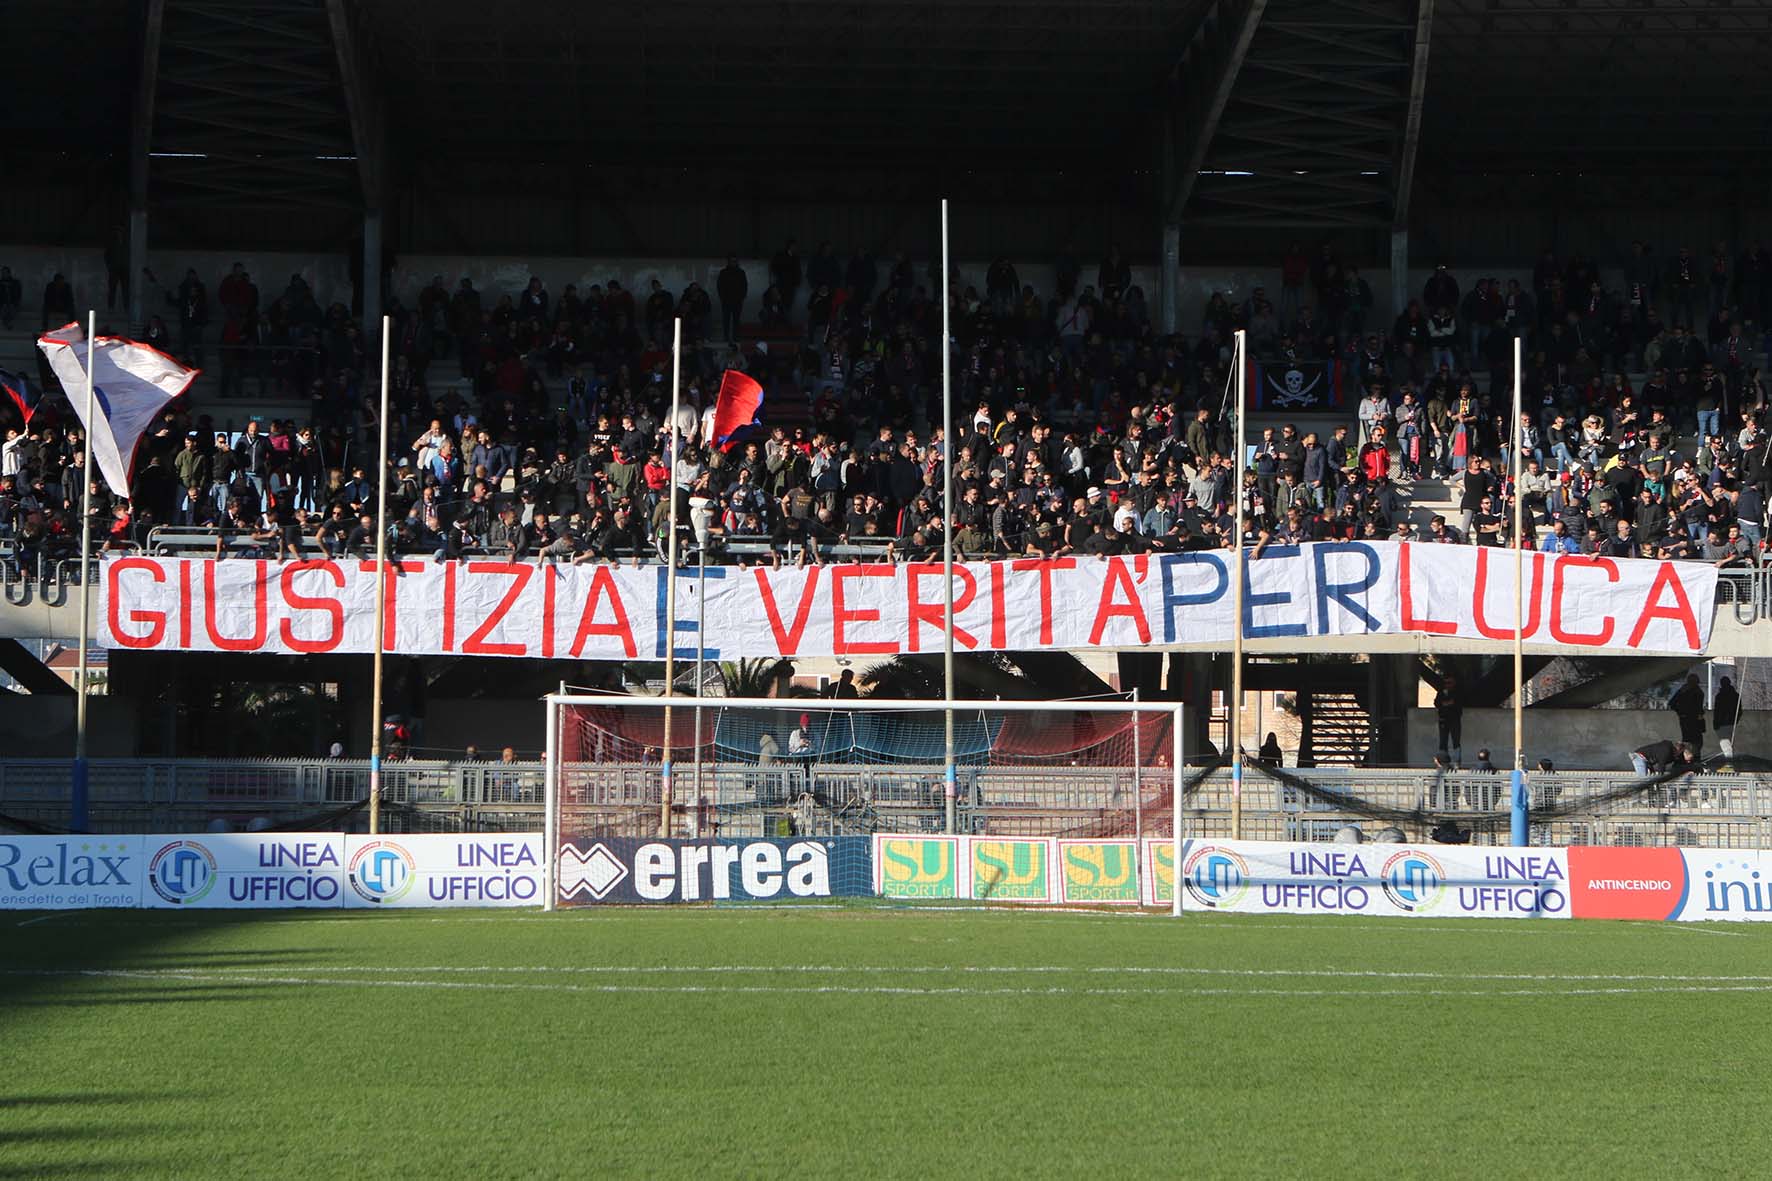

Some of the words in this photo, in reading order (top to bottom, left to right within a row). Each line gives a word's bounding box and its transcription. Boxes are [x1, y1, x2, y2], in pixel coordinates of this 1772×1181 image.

[107, 556, 638, 659] GIUSTIZIA
[656, 566, 726, 660] E
[1160, 540, 1382, 643] PER
[1400, 540, 1702, 650] LUCA
[259, 843, 340, 868] LINEA
[457, 843, 537, 867] LINEA
[1290, 852, 1368, 877] LINEA
[634, 841, 831, 900] errea
[1486, 856, 1564, 880] LINEA
[1587, 879, 1672, 891] ANTINCENDIO
[0, 893, 63, 904] enedetto
[68, 893, 89, 904] del
[93, 894, 134, 905] Tronto
